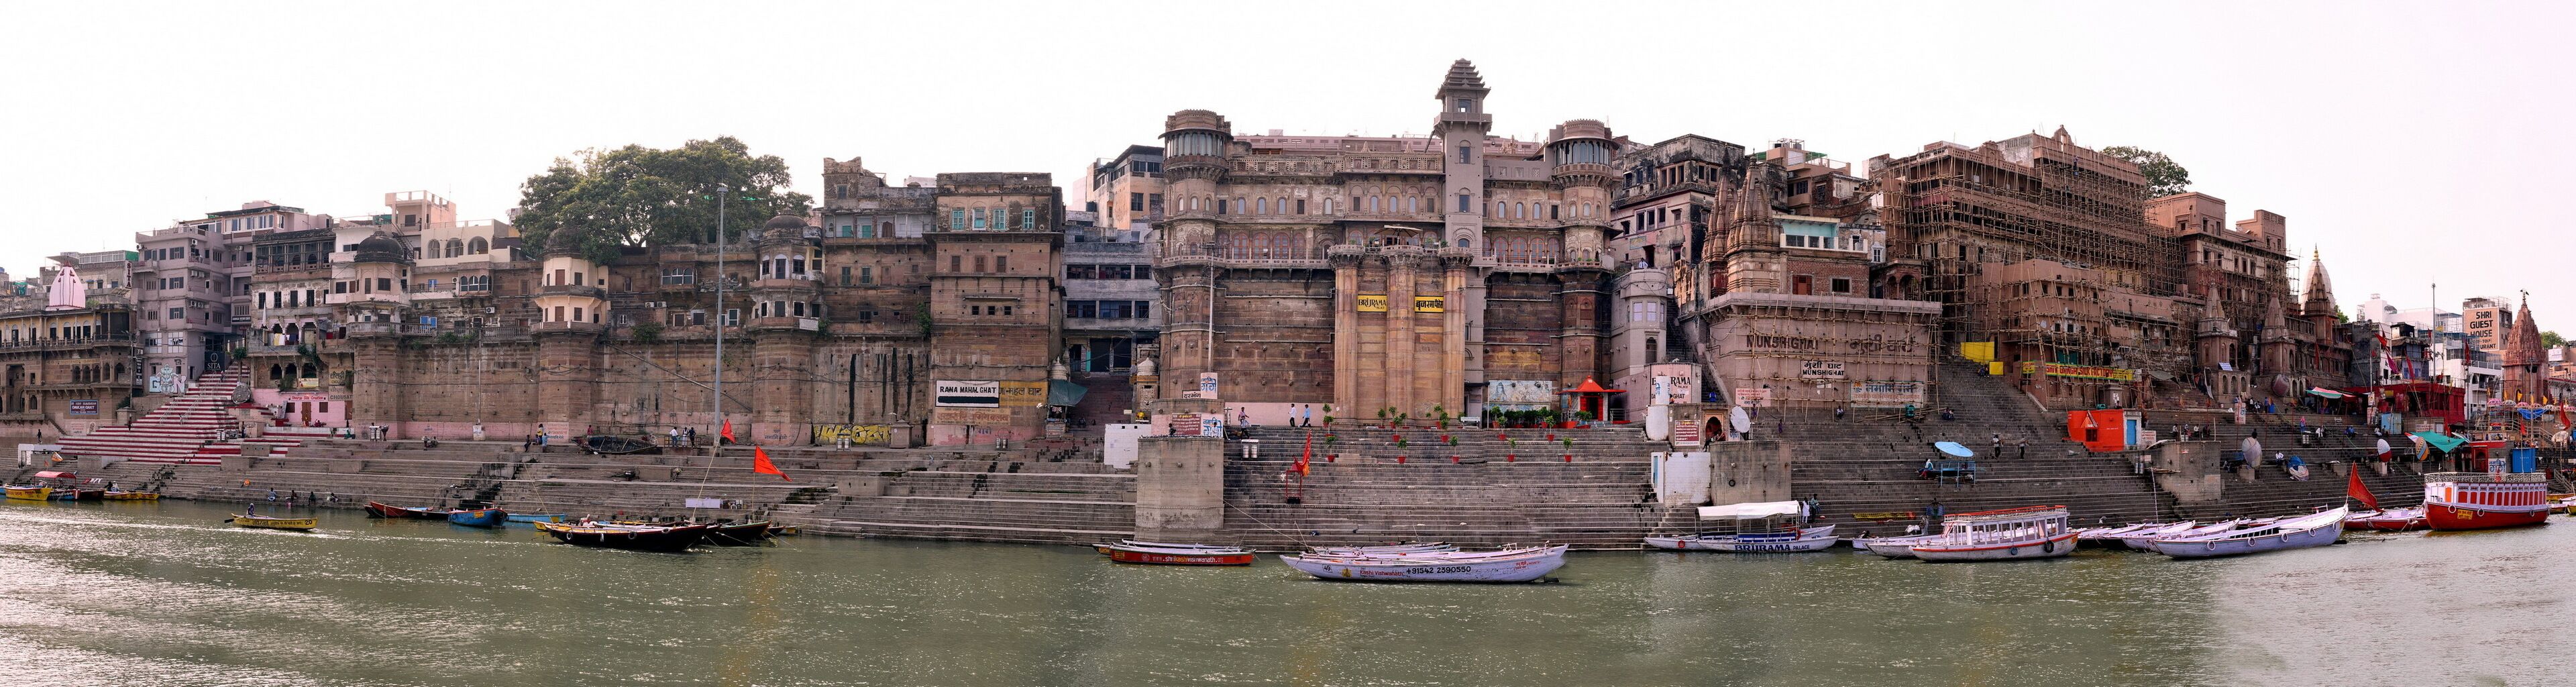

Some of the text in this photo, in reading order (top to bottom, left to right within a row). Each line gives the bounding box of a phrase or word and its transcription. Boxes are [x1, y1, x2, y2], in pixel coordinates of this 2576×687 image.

[1358, 298, 1386, 307] BRIJRAMA
[2475, 311, 2492, 319] SHRI
[2470, 319, 2493, 329] GUEST
[2470, 329, 2493, 337] HOUSE
[940, 386, 958, 394] RANA
[1028, 387, 1042, 396] घाट
[1406, 566, 1471, 575] +91542 2390550
